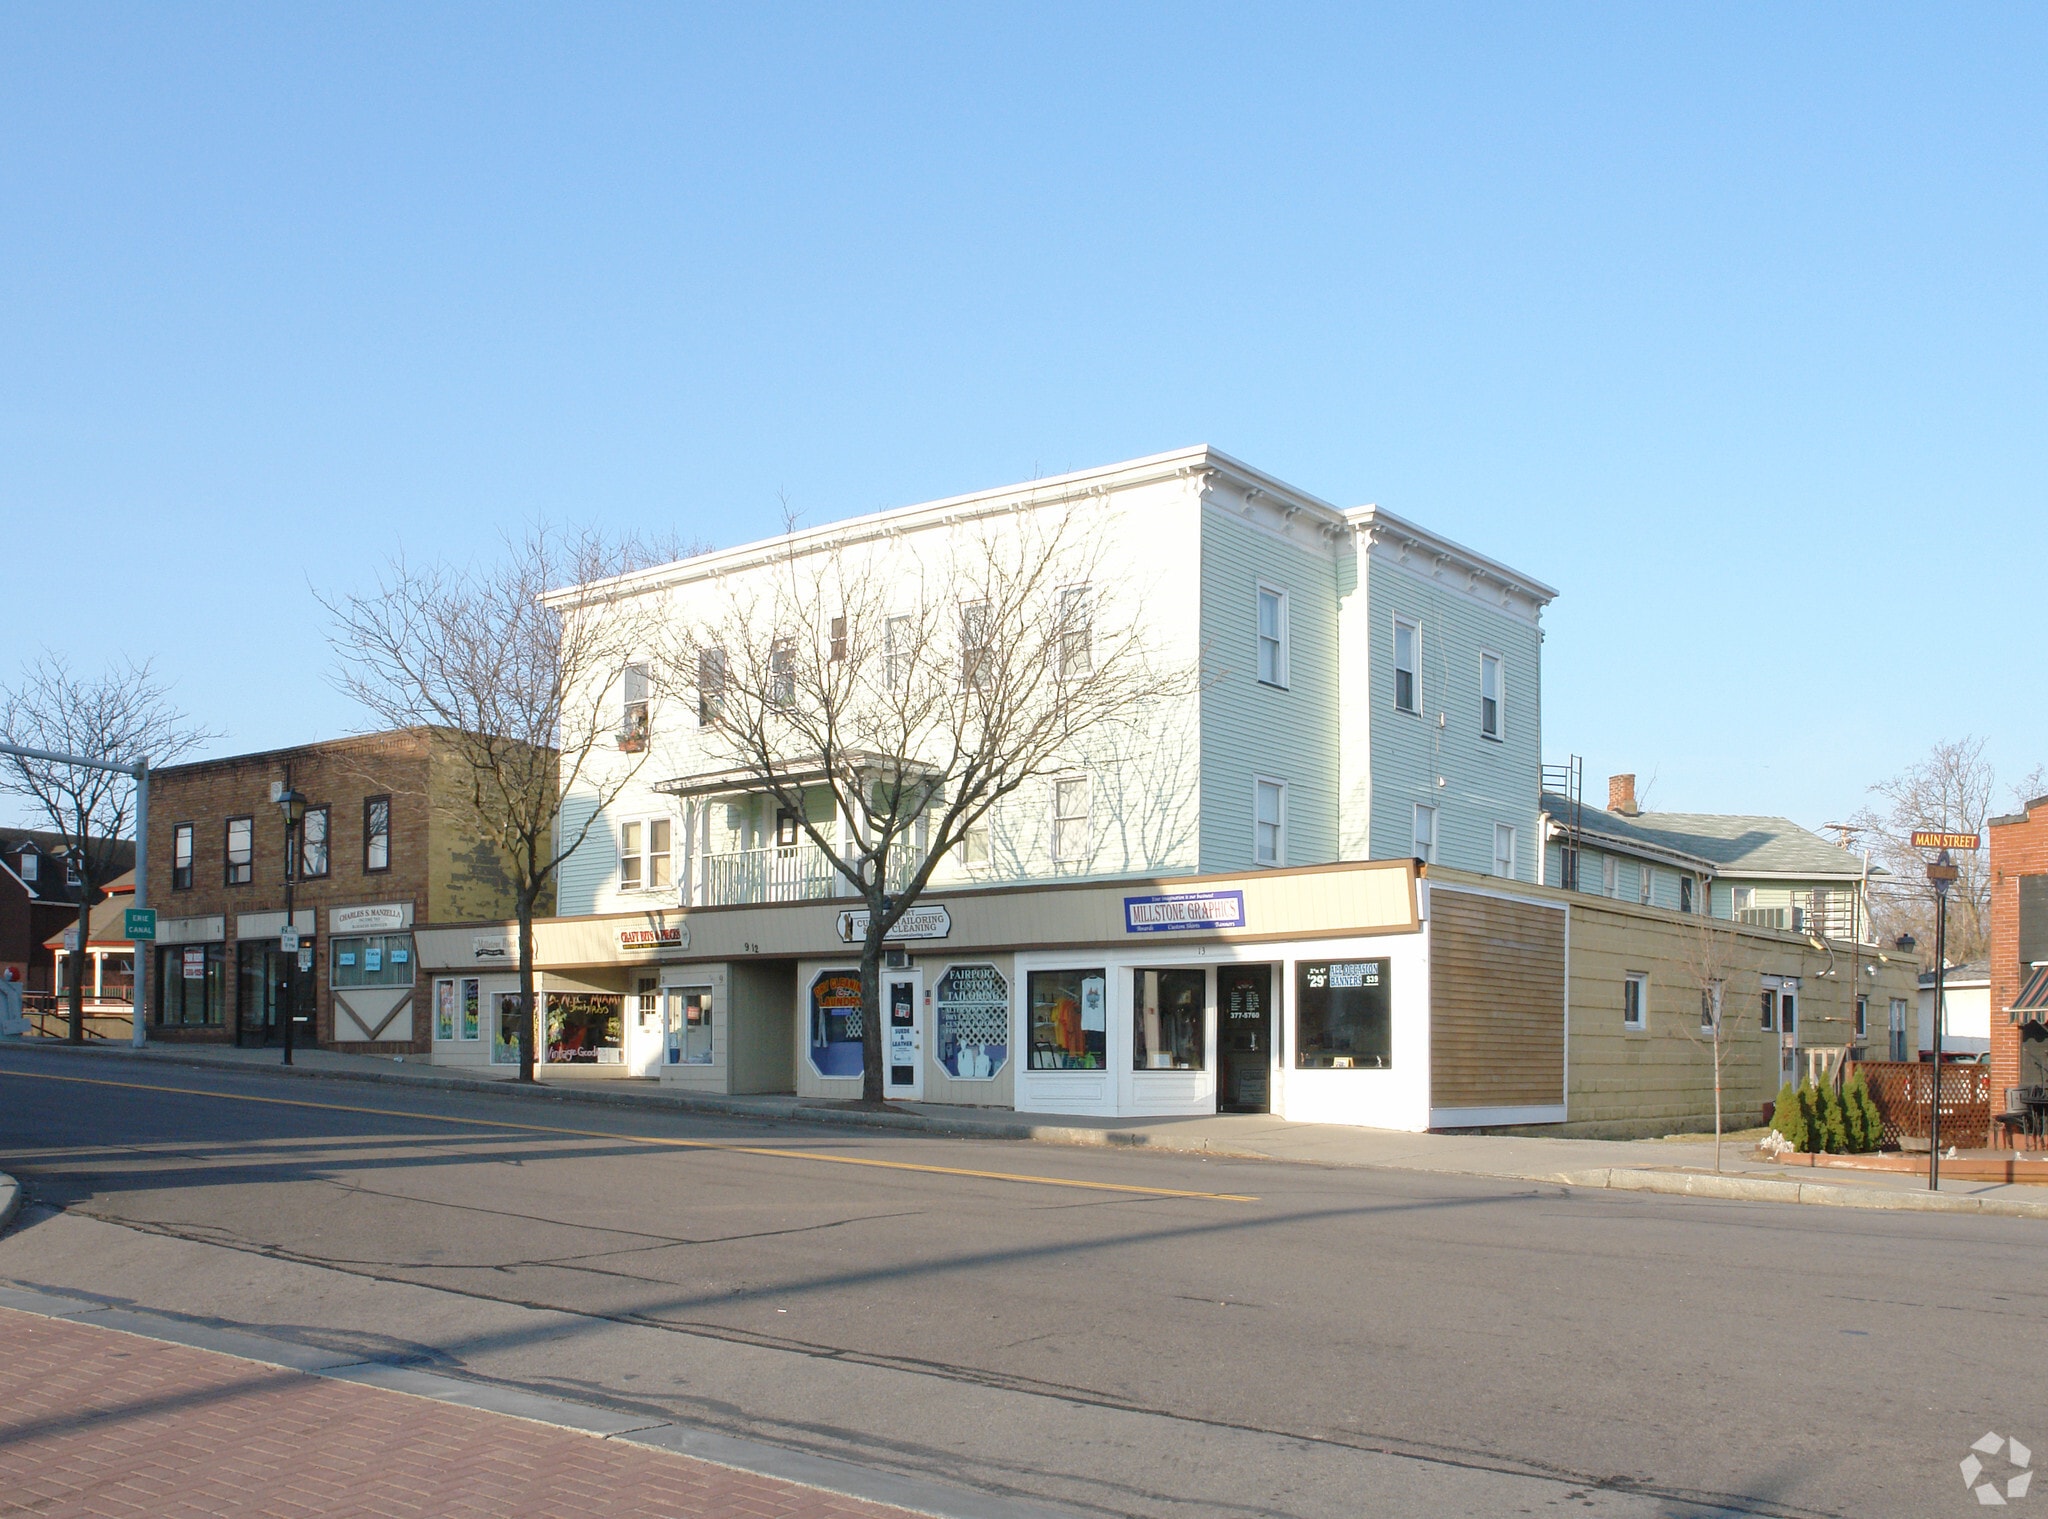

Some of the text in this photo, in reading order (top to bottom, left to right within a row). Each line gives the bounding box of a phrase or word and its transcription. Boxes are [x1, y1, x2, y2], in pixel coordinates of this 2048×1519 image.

[1915, 833, 1976, 848] MAIN STREET
[339, 910, 365, 922] CHARLES
[370, 908, 401, 918] MANZELLA
[1132, 900, 1237, 923] MILLSTONE GRAPHICS
[132, 914, 149, 922] ERIE
[128, 926, 152, 934] CANAL
[891, 923, 937, 933] CLEANING
[949, 969, 995, 980] FAIRPORT
[1330, 962, 1379, 976] ALL OCCASION
[813, 977, 862, 998] DRY CLEANIN
[952, 980, 993, 990] CUSTOM
[1330, 975, 1362, 988] BANNERS
[947, 991, 1000, 1001] TAILORING
